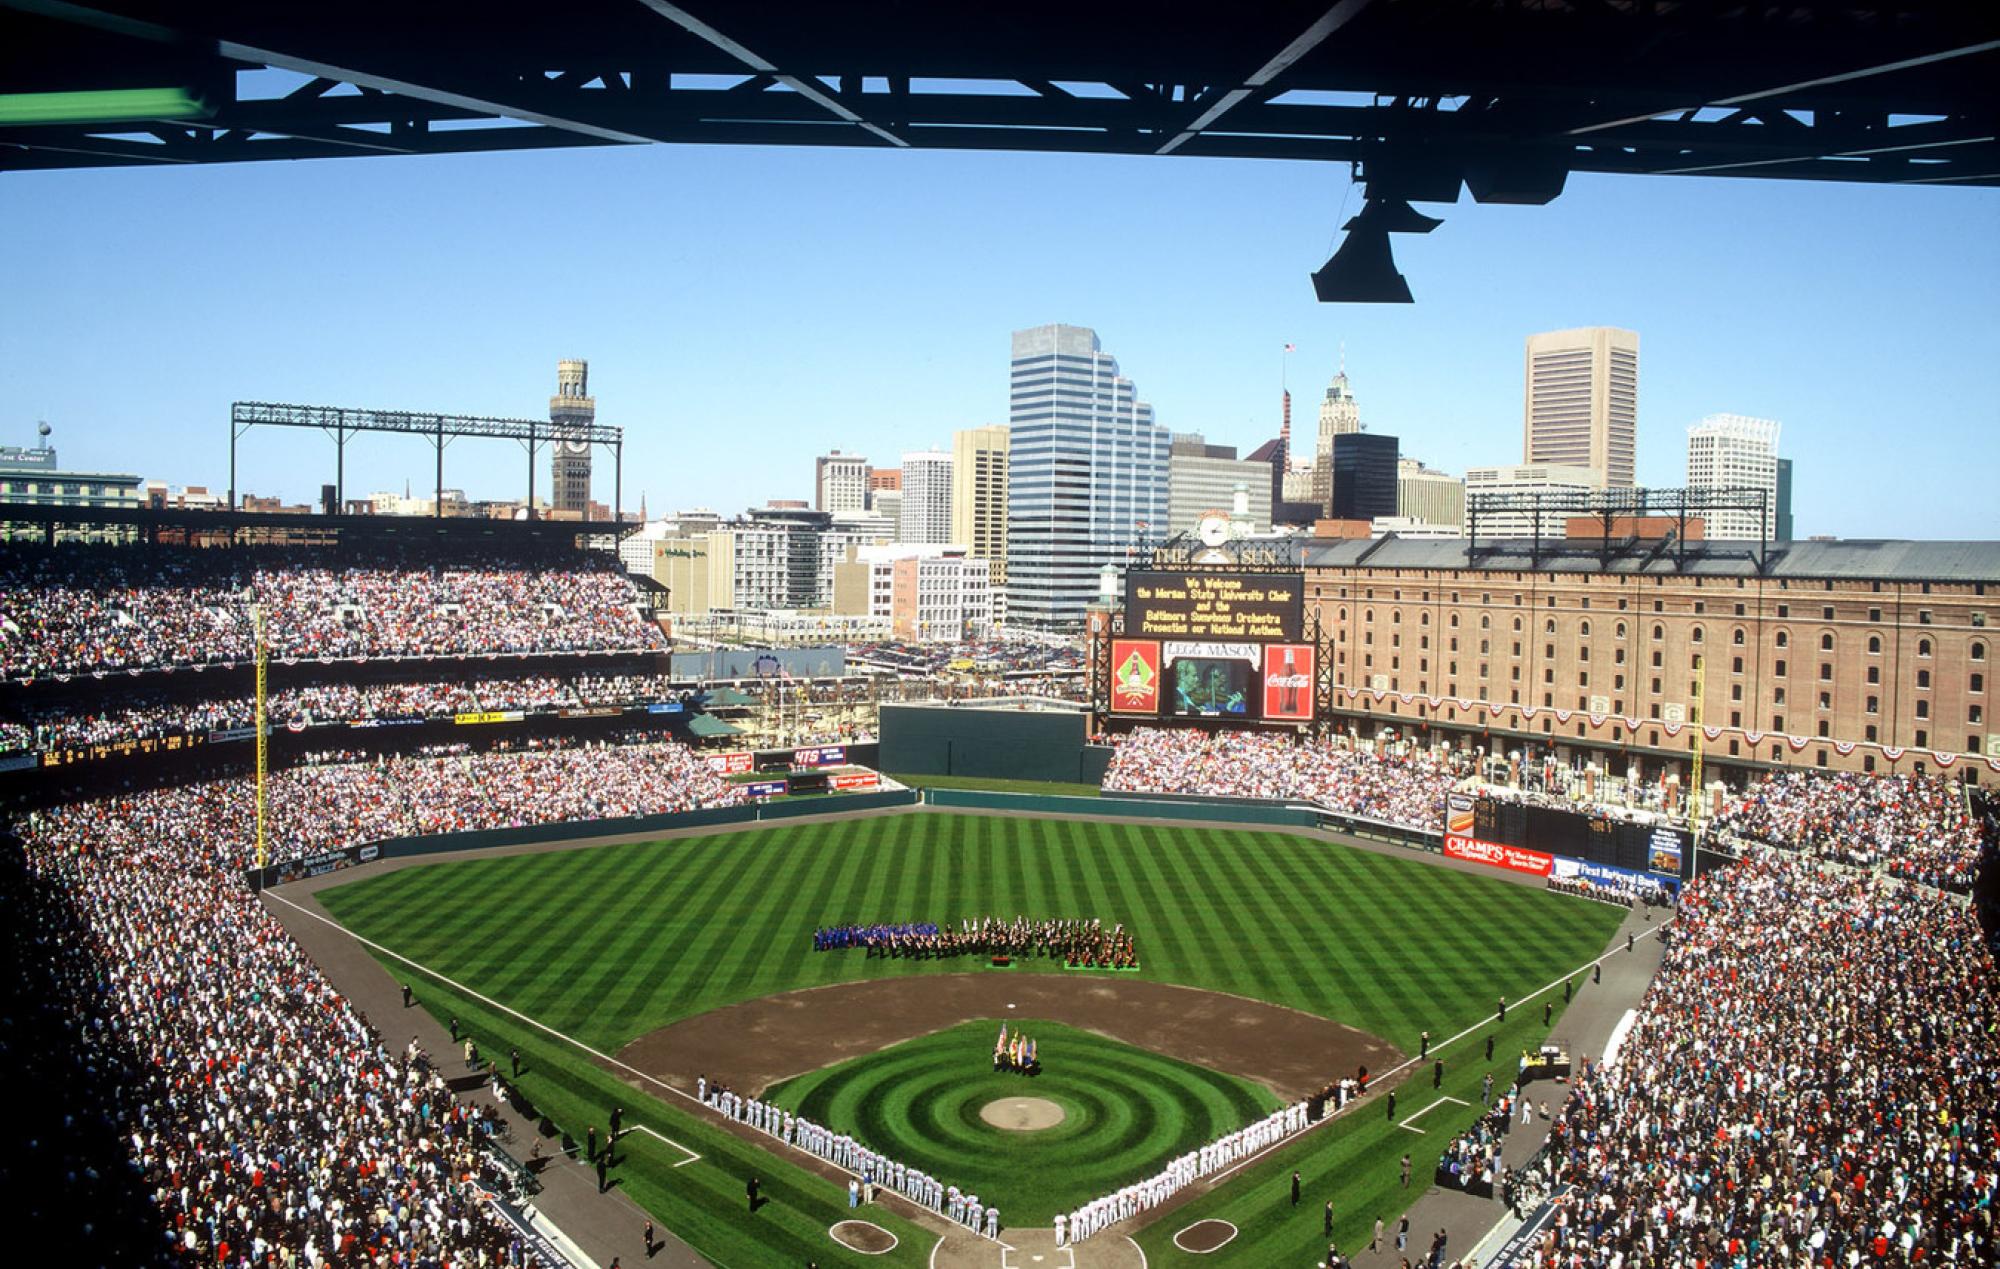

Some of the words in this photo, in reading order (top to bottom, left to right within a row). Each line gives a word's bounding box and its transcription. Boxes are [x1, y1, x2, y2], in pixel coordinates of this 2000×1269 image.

[664, 548, 691, 559] Holiday
[692, 549, 707, 559] Inn
[1155, 547, 1189, 563] THE
[1241, 549, 1277, 565] SUN
[1185, 577, 1200, 588] We
[1204, 577, 1242, 590] Welcome
[1137, 587, 1152, 599] the
[1155, 587, 1186, 599] Morgan
[1190, 588, 1215, 600] State
[1219, 589, 1264, 601] University
[1268, 590, 1291, 602] Choir
[1196, 601, 1211, 611] and
[1215, 600, 1230, 612] the
[1146, 609, 1186, 621] Baltimore
[1190, 611, 1232, 623] Symphony
[1236, 612, 1280, 624] Orchestra
[1142, 621, 1187, 633] Presenting
[1191, 625, 1206, 633] our
[1211, 623, 1245, 635] National
[1166, 642, 1201, 655] LEGG
[1207, 643, 1257, 657] MASON
[1267, 672, 1310, 688] Coca-Cola
[1447, 836, 1504, 861] CHAMPS
[1580, 863, 1601, 877] First
[1601, 867, 1637, 884] National
[1638, 873, 1660, 889] Bank
